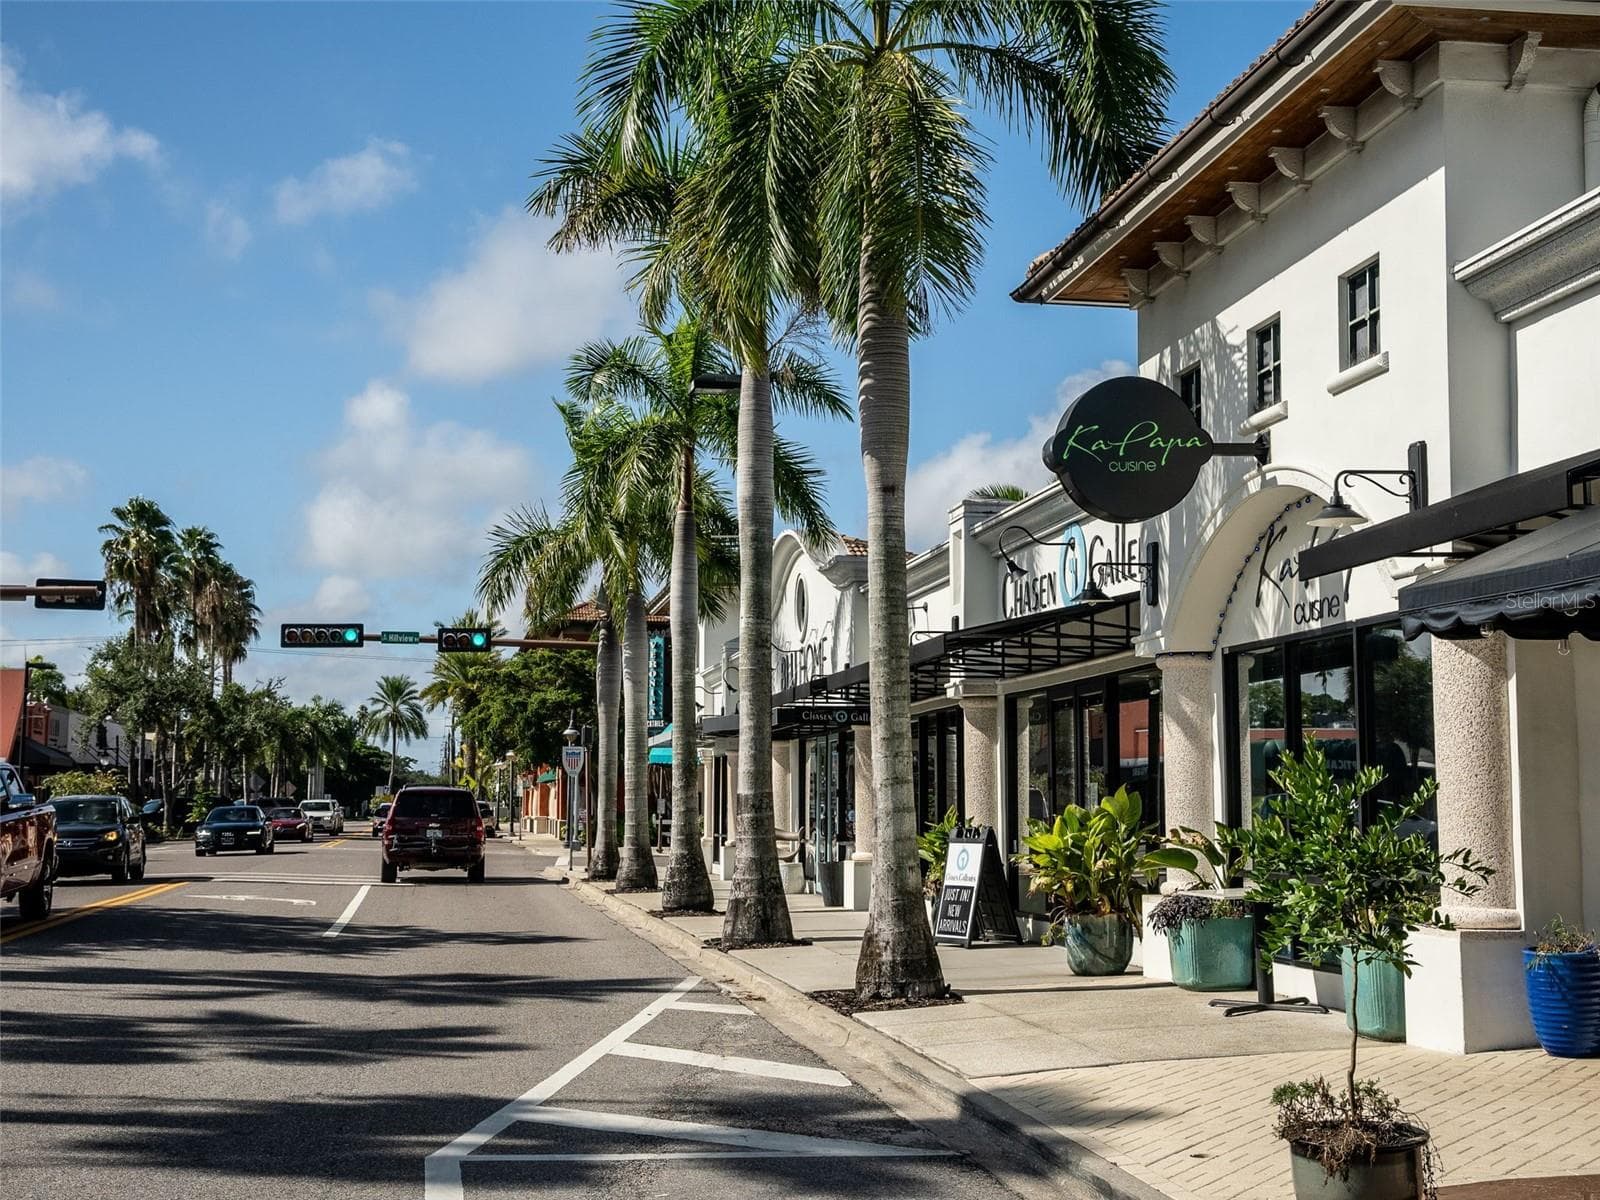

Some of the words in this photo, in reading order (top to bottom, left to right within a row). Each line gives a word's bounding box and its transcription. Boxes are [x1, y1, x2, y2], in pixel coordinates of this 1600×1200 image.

[648, 641, 658, 716] VERONICA
[944, 889, 959, 901] JUST
[960, 889, 971, 902] IN!
[947, 904, 962, 917] NEW
[939, 919, 967, 933] ARRIVALS
